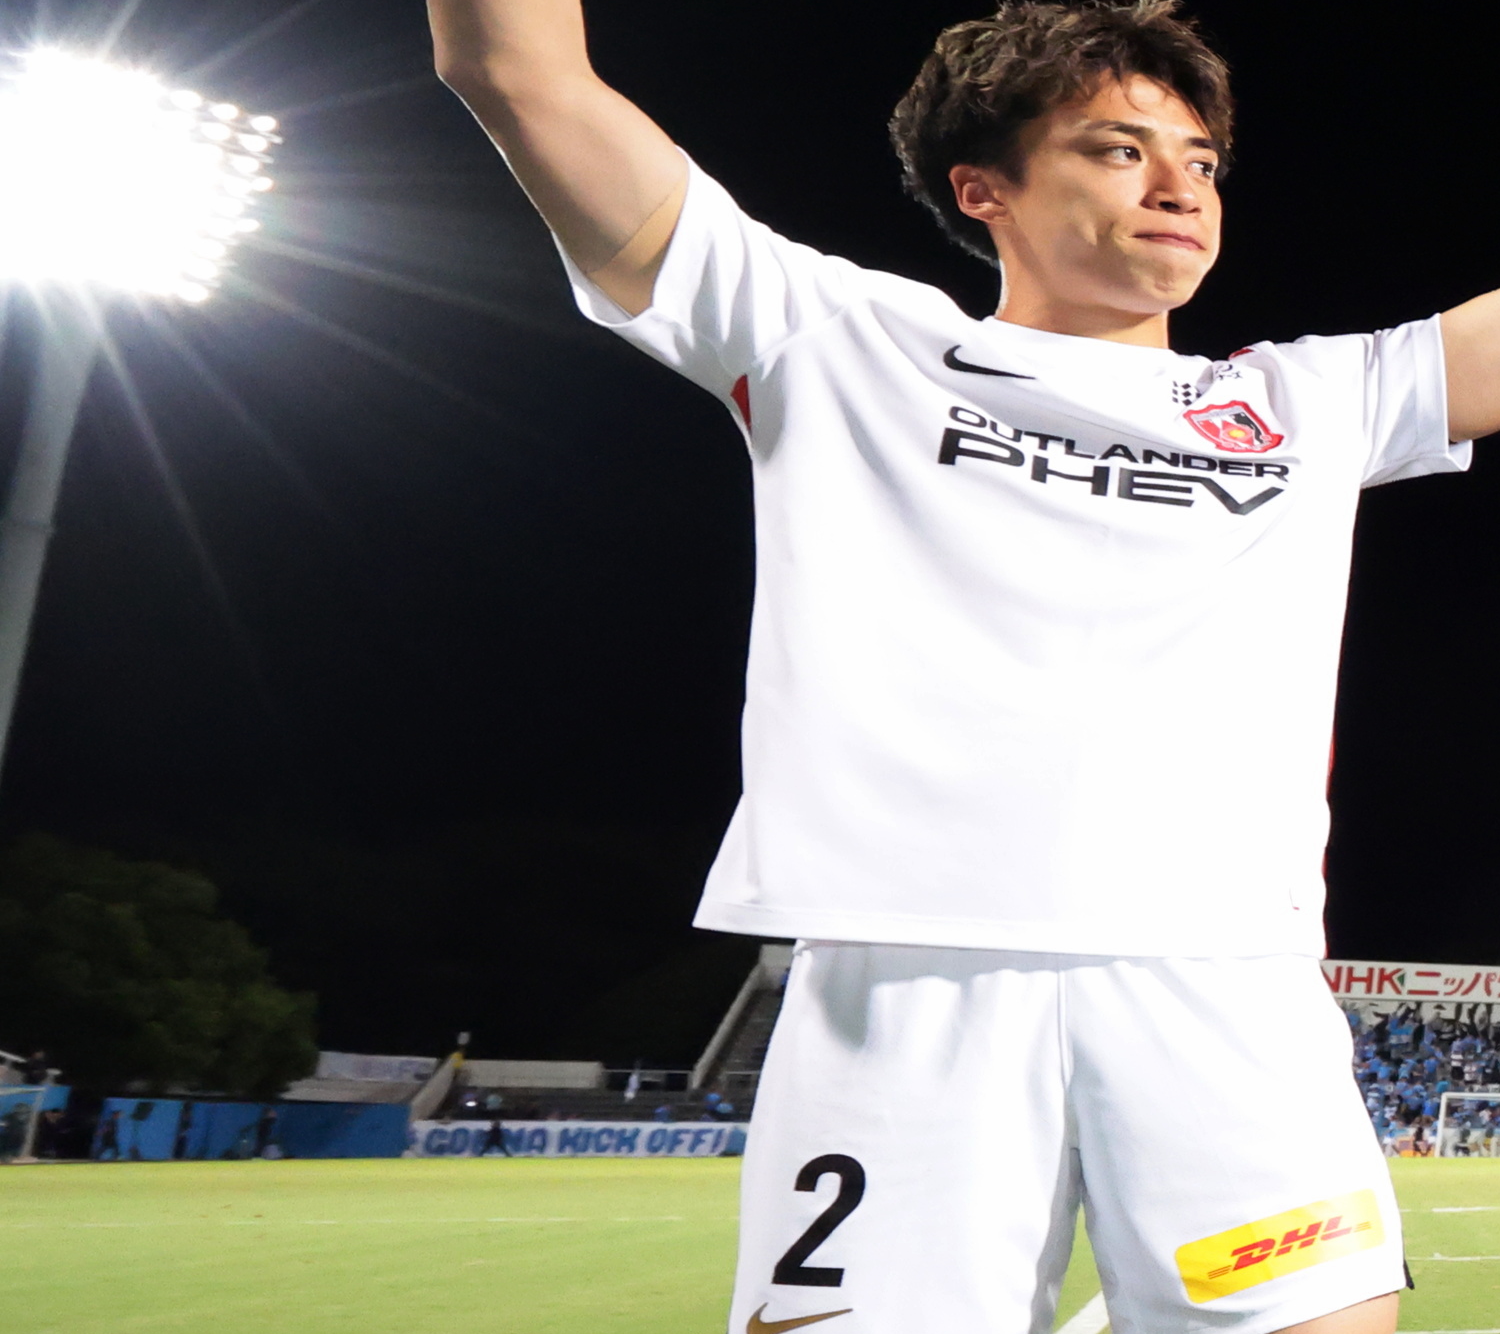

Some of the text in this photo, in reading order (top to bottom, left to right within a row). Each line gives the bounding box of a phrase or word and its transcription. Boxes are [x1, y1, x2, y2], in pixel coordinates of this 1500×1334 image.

[937, 426, 1285, 516] PHEV
[949, 405, 1290, 482] OUTLANDER
[558, 1127, 640, 1153] KICK
[771, 1154, 866, 1287] 2
[1231, 1216, 1353, 1272] DHL
